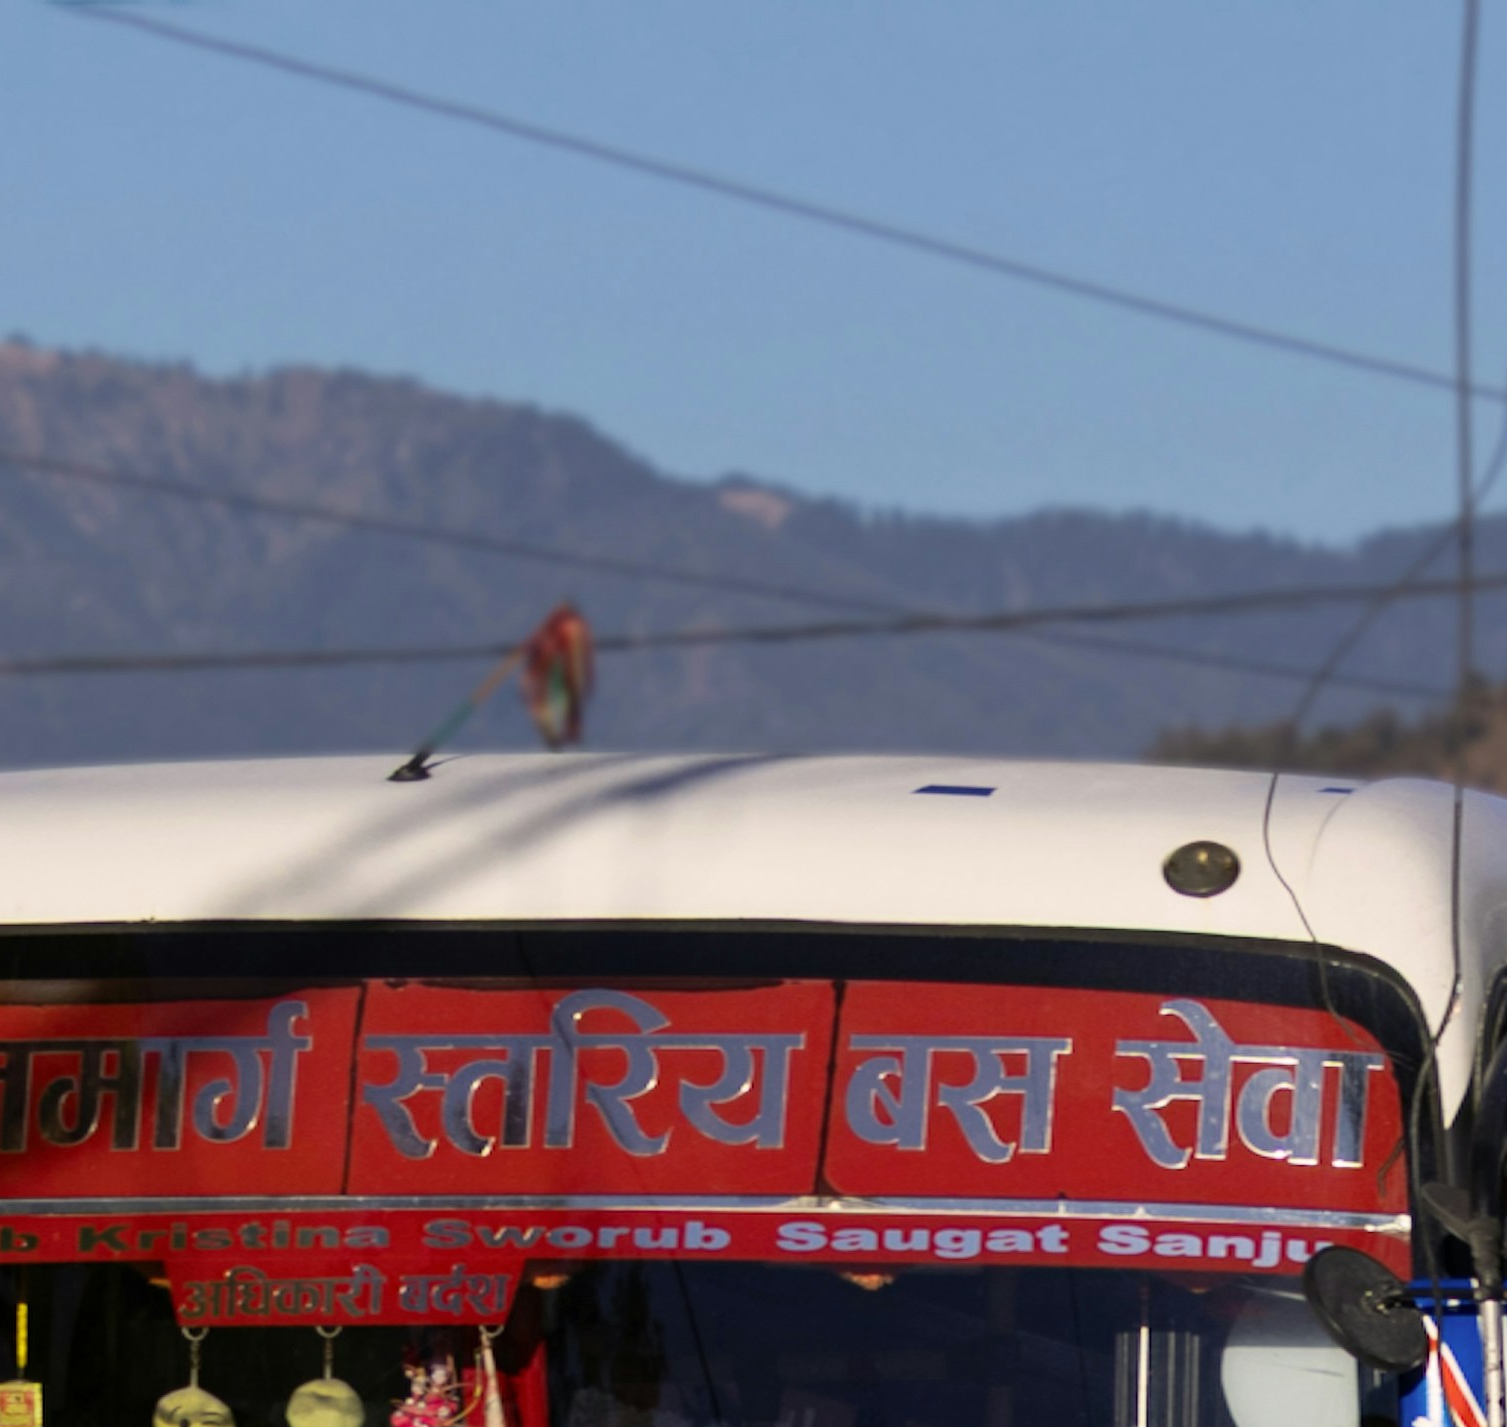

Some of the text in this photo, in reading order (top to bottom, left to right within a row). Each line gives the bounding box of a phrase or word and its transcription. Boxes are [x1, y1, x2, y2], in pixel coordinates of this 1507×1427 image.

[361, 988, 805, 1160] स्तरिय
[843, 1035, 1073, 1167] बस
[1111, 1000, 1385, 1170] सेवा
[76, 1218, 391, 1253] Kristina
[422, 1218, 733, 1252] Sworub
[775, 1220, 1069, 1259] Saugat
[1097, 1224, 1333, 1268] Sanju
[178, 1262, 388, 1319] अधिकारी
